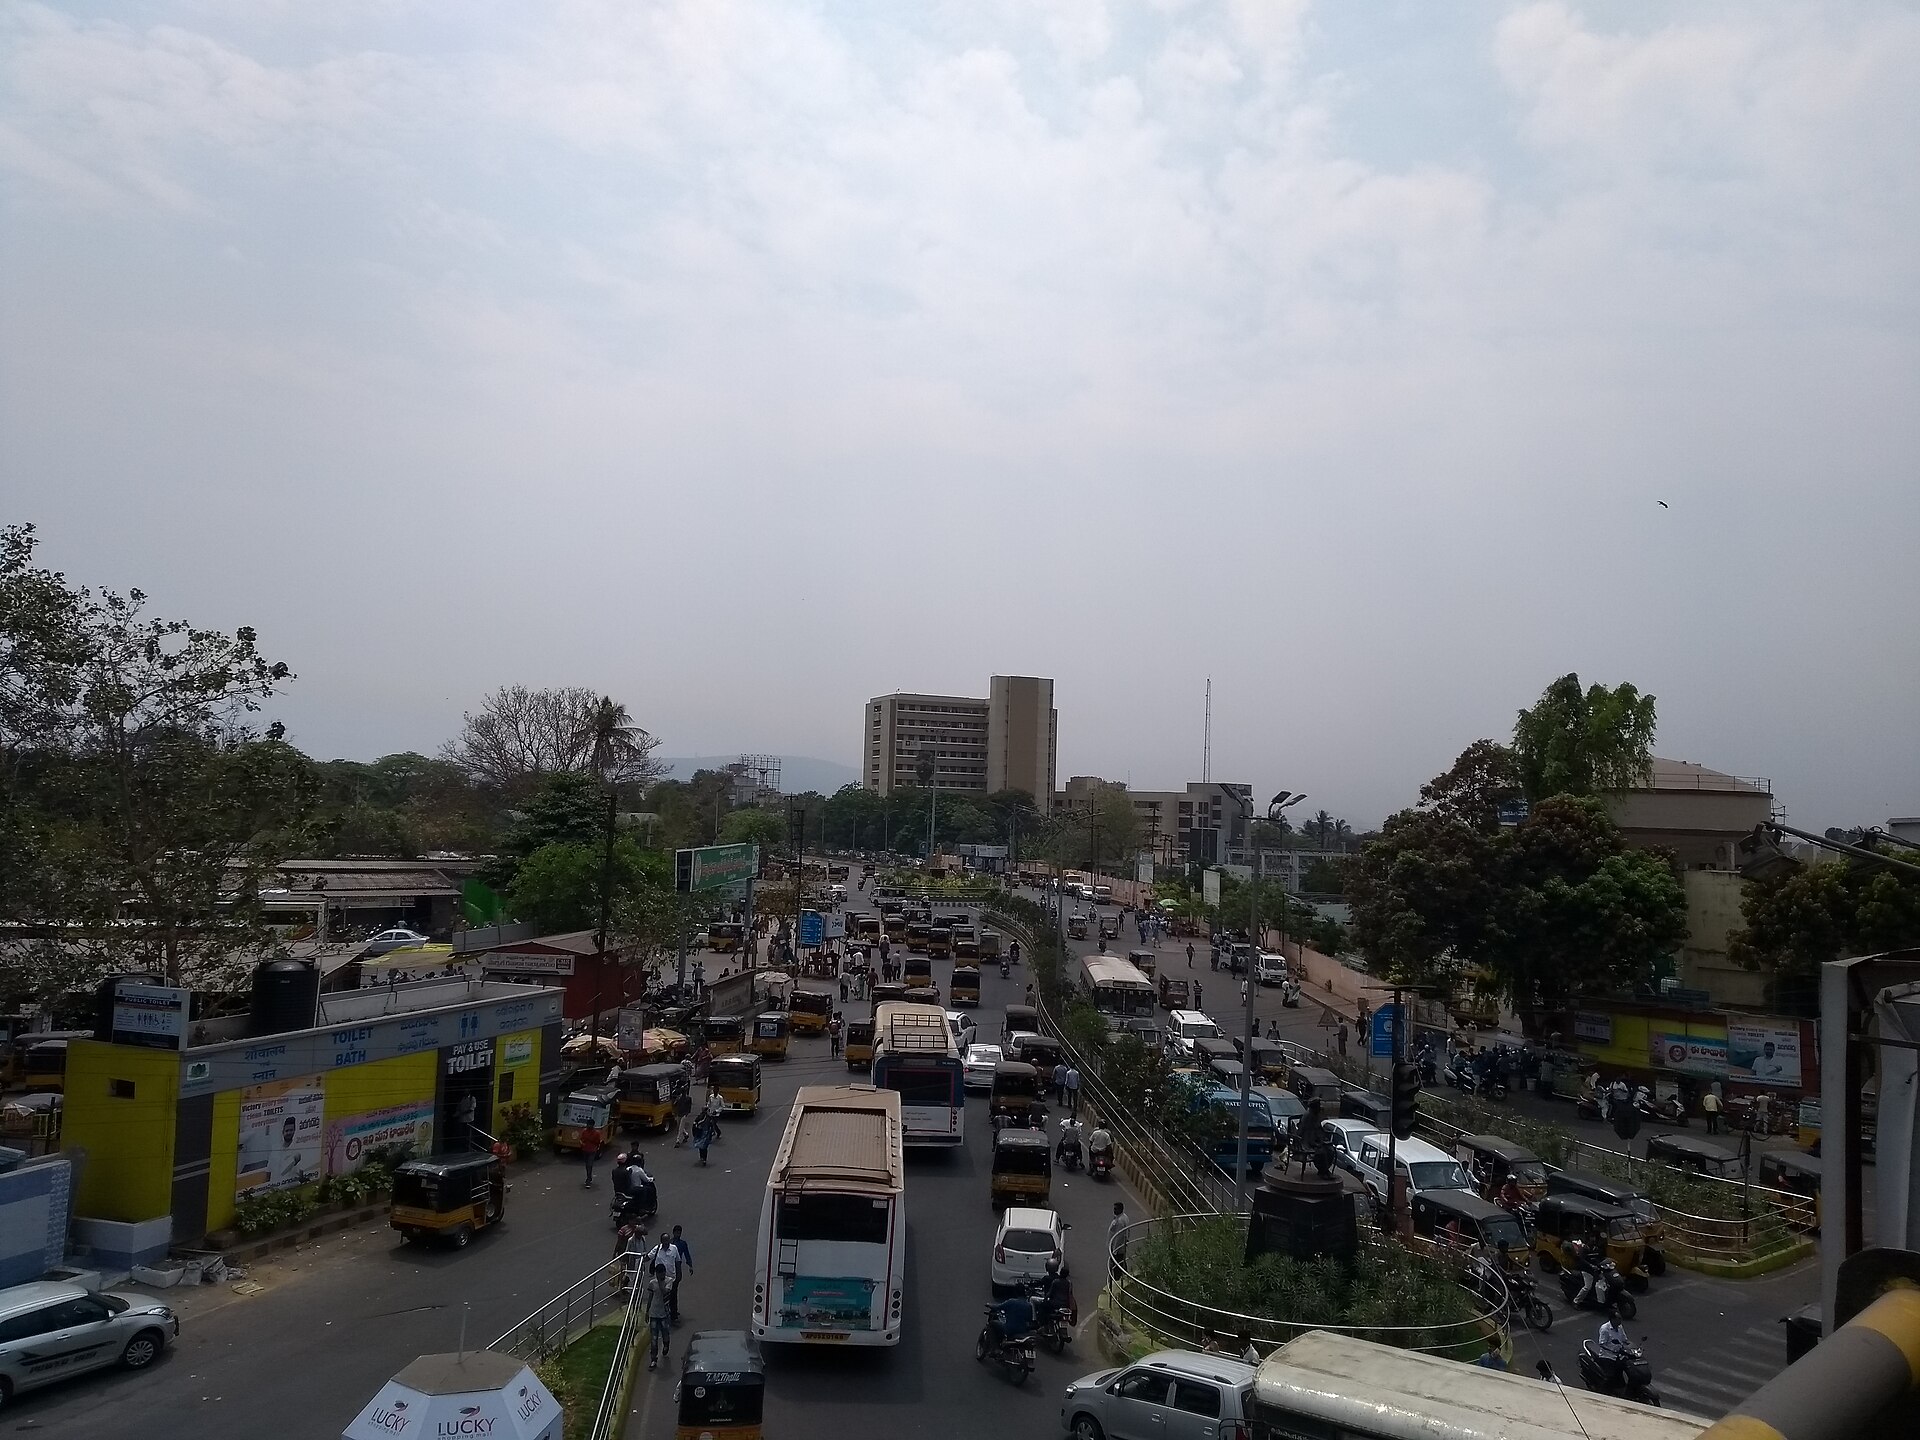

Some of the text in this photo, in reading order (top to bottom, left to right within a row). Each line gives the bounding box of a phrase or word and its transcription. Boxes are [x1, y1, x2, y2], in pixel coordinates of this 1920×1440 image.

[148, 998, 171, 1006] TOILET
[332, 1027, 374, 1044] TOILET
[453, 1044, 467, 1056] PAY
[468, 1042, 474, 1052] &
[474, 1039, 489, 1051] USE
[335, 1050, 366, 1066] BATH
[446, 1049, 494, 1075] TOILET
[242, 1103, 261, 1113] Victory
[263, 1106, 284, 1116] TOILETS
[517, 1389, 542, 1421] LUCKY
[371, 1407, 410, 1432] LUCKY
[438, 1417, 496, 1436] LUCKY
